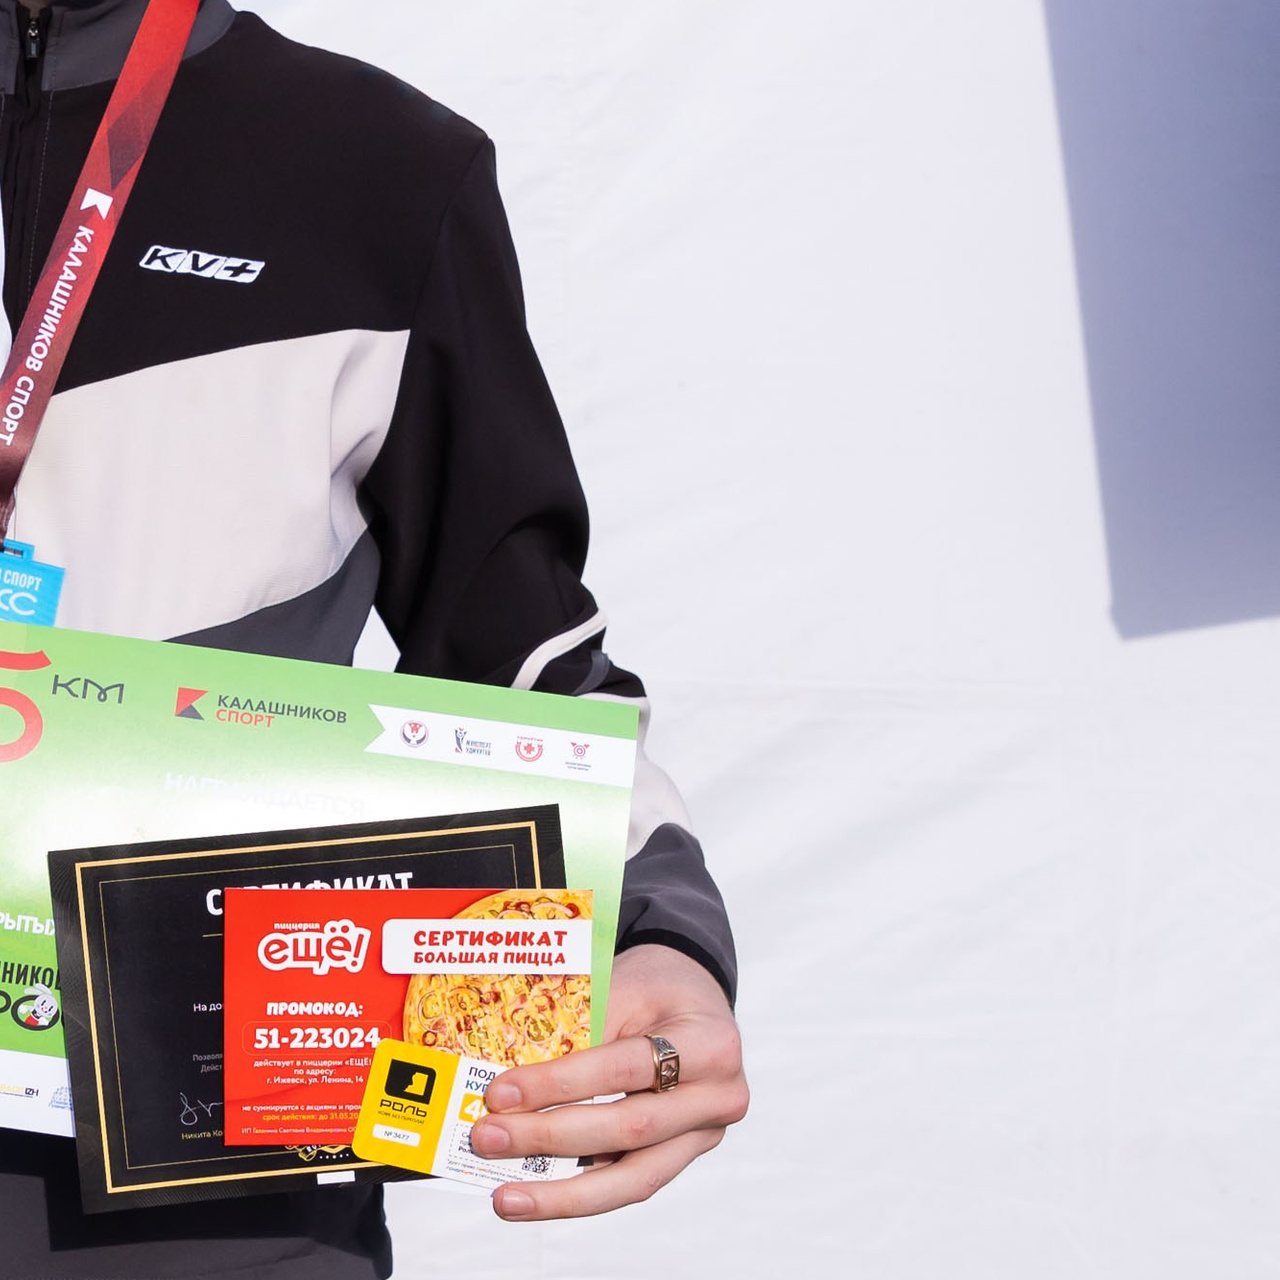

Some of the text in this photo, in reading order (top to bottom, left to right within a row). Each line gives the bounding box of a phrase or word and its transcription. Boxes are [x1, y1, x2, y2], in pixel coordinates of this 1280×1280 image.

[25, 225, 95, 372] КАЛАШНИКОВ
[3, 569, 42, 592] СПОРТ
[218, 694, 348, 724] КАЛАШНИКОВ
[216, 709, 275, 729] СПОРТ
[273, 922, 321, 931] пиццерия
[413, 930, 568, 947] СЕРТИФИКАТ
[413, 951, 566, 965] БОЛЬШАЯ ПИЦЦА
[193, 1003, 207, 1012] На
[266, 1002, 363, 1017] ПРОМОКОД:
[253, 1027, 381, 1049] 51-223024
[253, 1059, 294, 1068] действует
[302, 1060, 343, 1068] пиццерии
[274, 1076, 307, 1085] Ижевск,
[308, 1077, 319, 1085] ул.
[320, 1075, 354, 1085] Ленина,
[355, 1075, 363, 1083] 14
[305, 1069, 336, 1077] адресу:
[379, 1099, 428, 1118] РОЛЬ
[463, 1101, 488, 1121] 4
[181, 1131, 211, 1140] Никита
